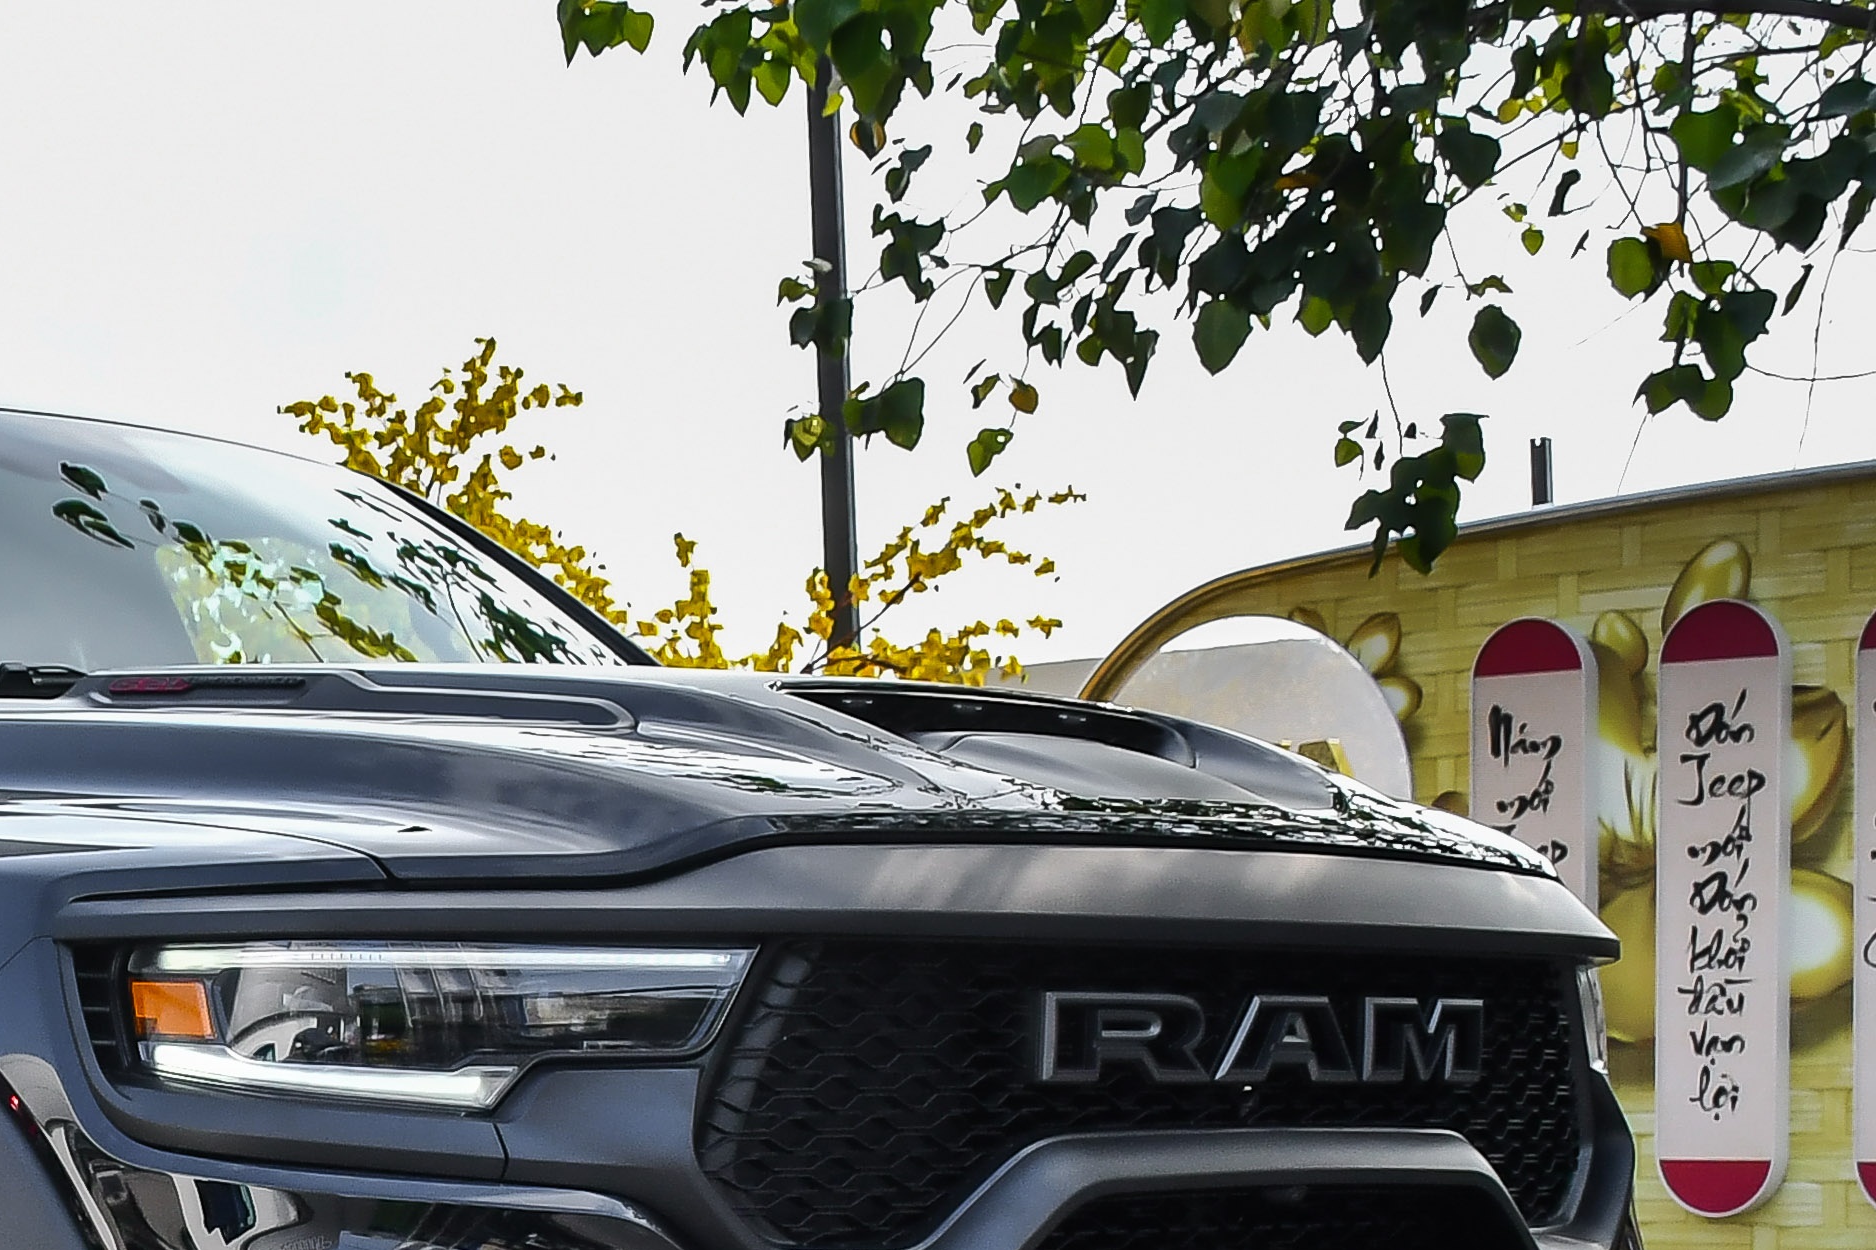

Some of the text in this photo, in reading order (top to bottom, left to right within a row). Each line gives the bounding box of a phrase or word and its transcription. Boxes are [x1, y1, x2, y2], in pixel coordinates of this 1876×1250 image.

[1496, 760, 1554, 819] mới
[1677, 753, 1766, 822] Jeep
[1041, 991, 1484, 1081] RAM
